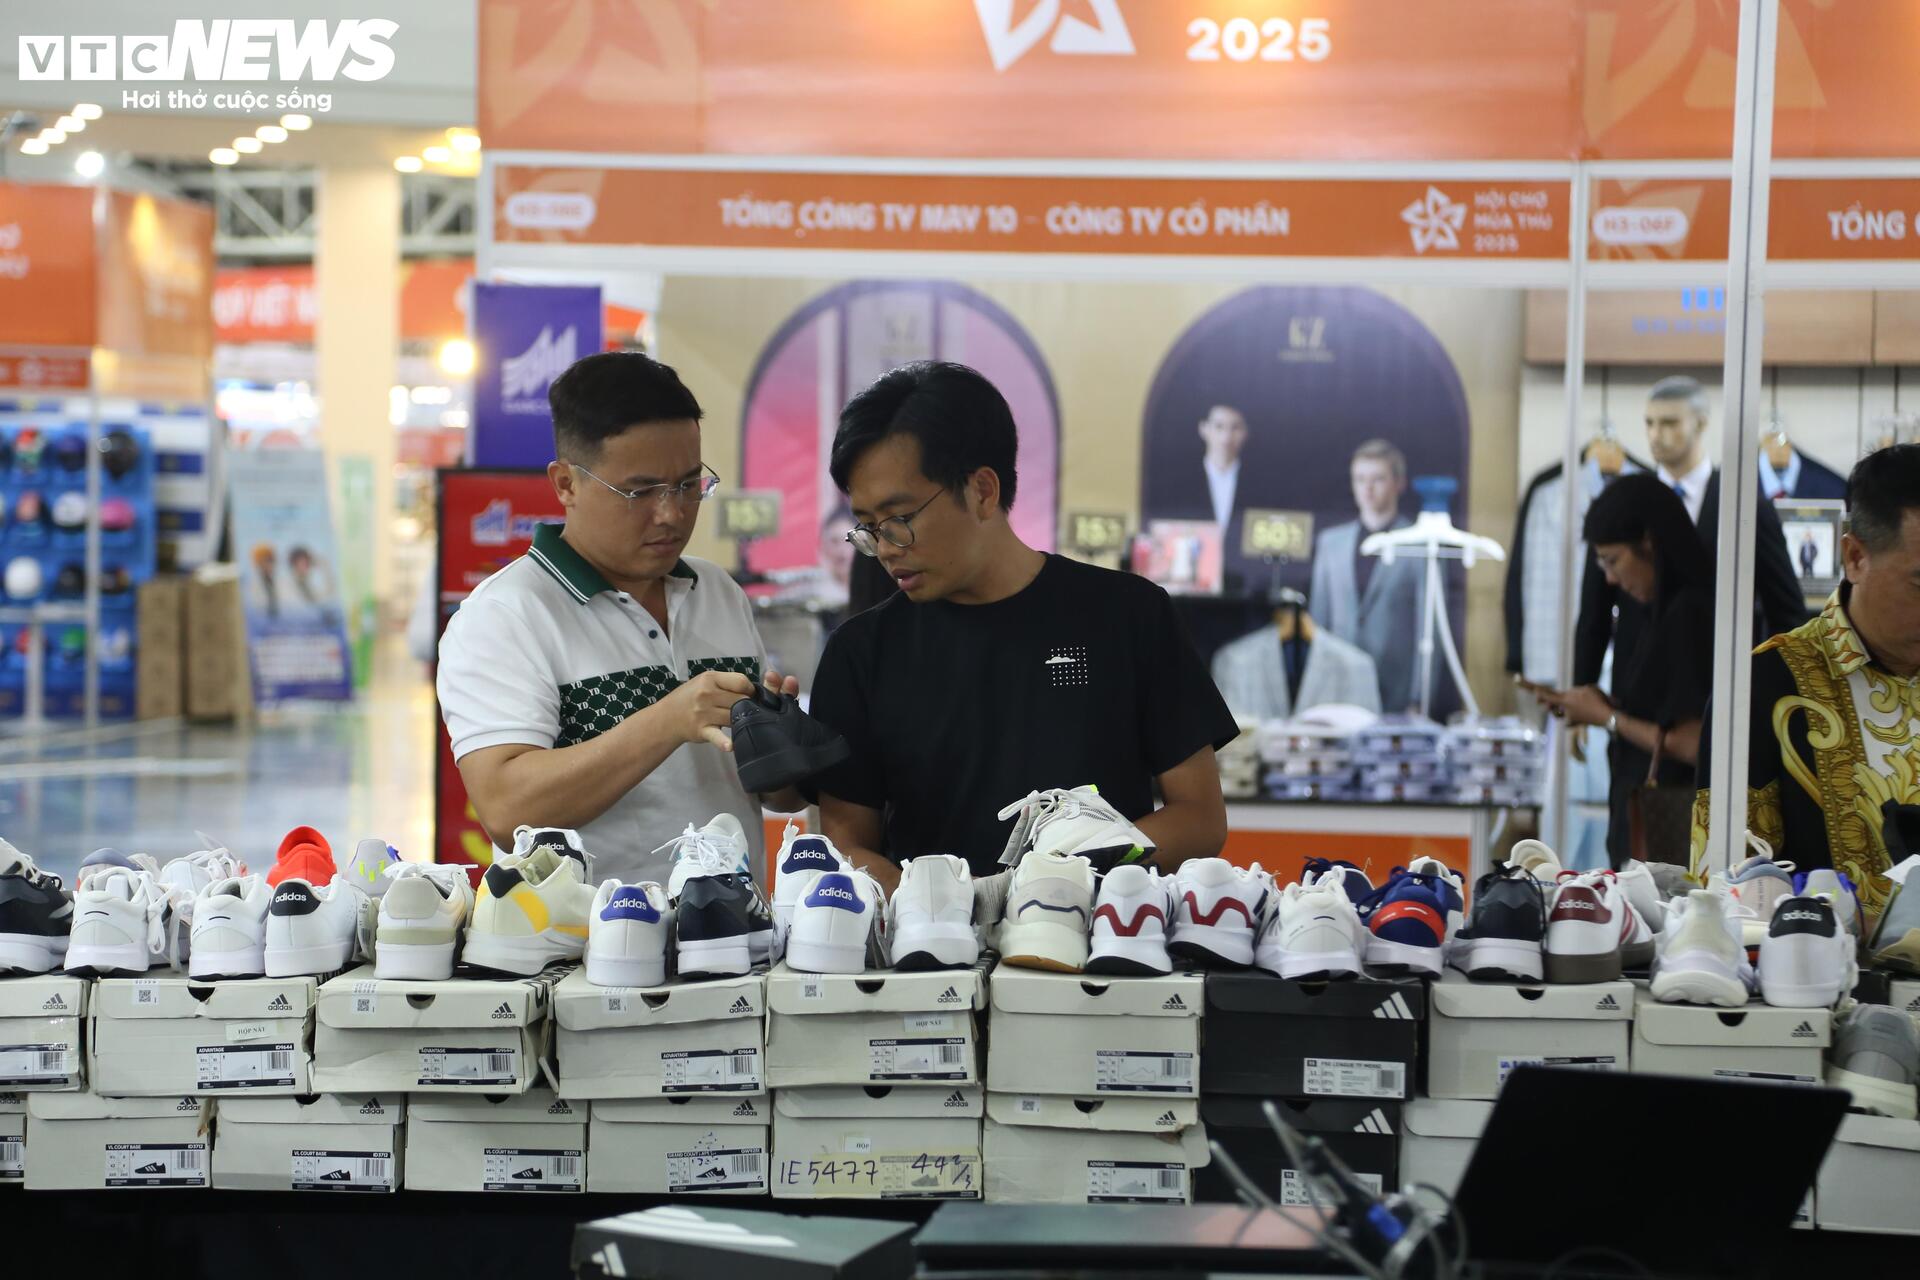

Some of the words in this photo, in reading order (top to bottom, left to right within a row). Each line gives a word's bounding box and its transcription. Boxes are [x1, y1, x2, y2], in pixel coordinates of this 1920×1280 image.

[1186, 17, 1331, 61] 2025
[719, 190, 793, 229] TỔNG
[799, 197, 876, 231] CÔNG
[987, 205, 1018, 233] 10
[1046, 202, 1123, 234] CÔNG
[1827, 200, 1905, 240] TỔNG
[571, 681, 583, 690] YD
[656, 683, 665, 691] YD
[589, 688, 600, 696] YD
[632, 688, 642, 696] YD
[607, 694, 617, 702] YD
[577, 701, 589, 711] YD
[623, 701, 633, 709] YD
[595, 707, 607, 716] YD
[613, 714, 624, 723] YD
[583, 722, 595, 731] YD
[793, 849, 826, 860] adidas
[275, 892, 307, 903] adidas
[819, 887, 853, 901] adidas
[613, 898, 647, 910] adidas
[1559, 899, 1594, 910] adidas
[268, 1003, 292, 1011] adidas
